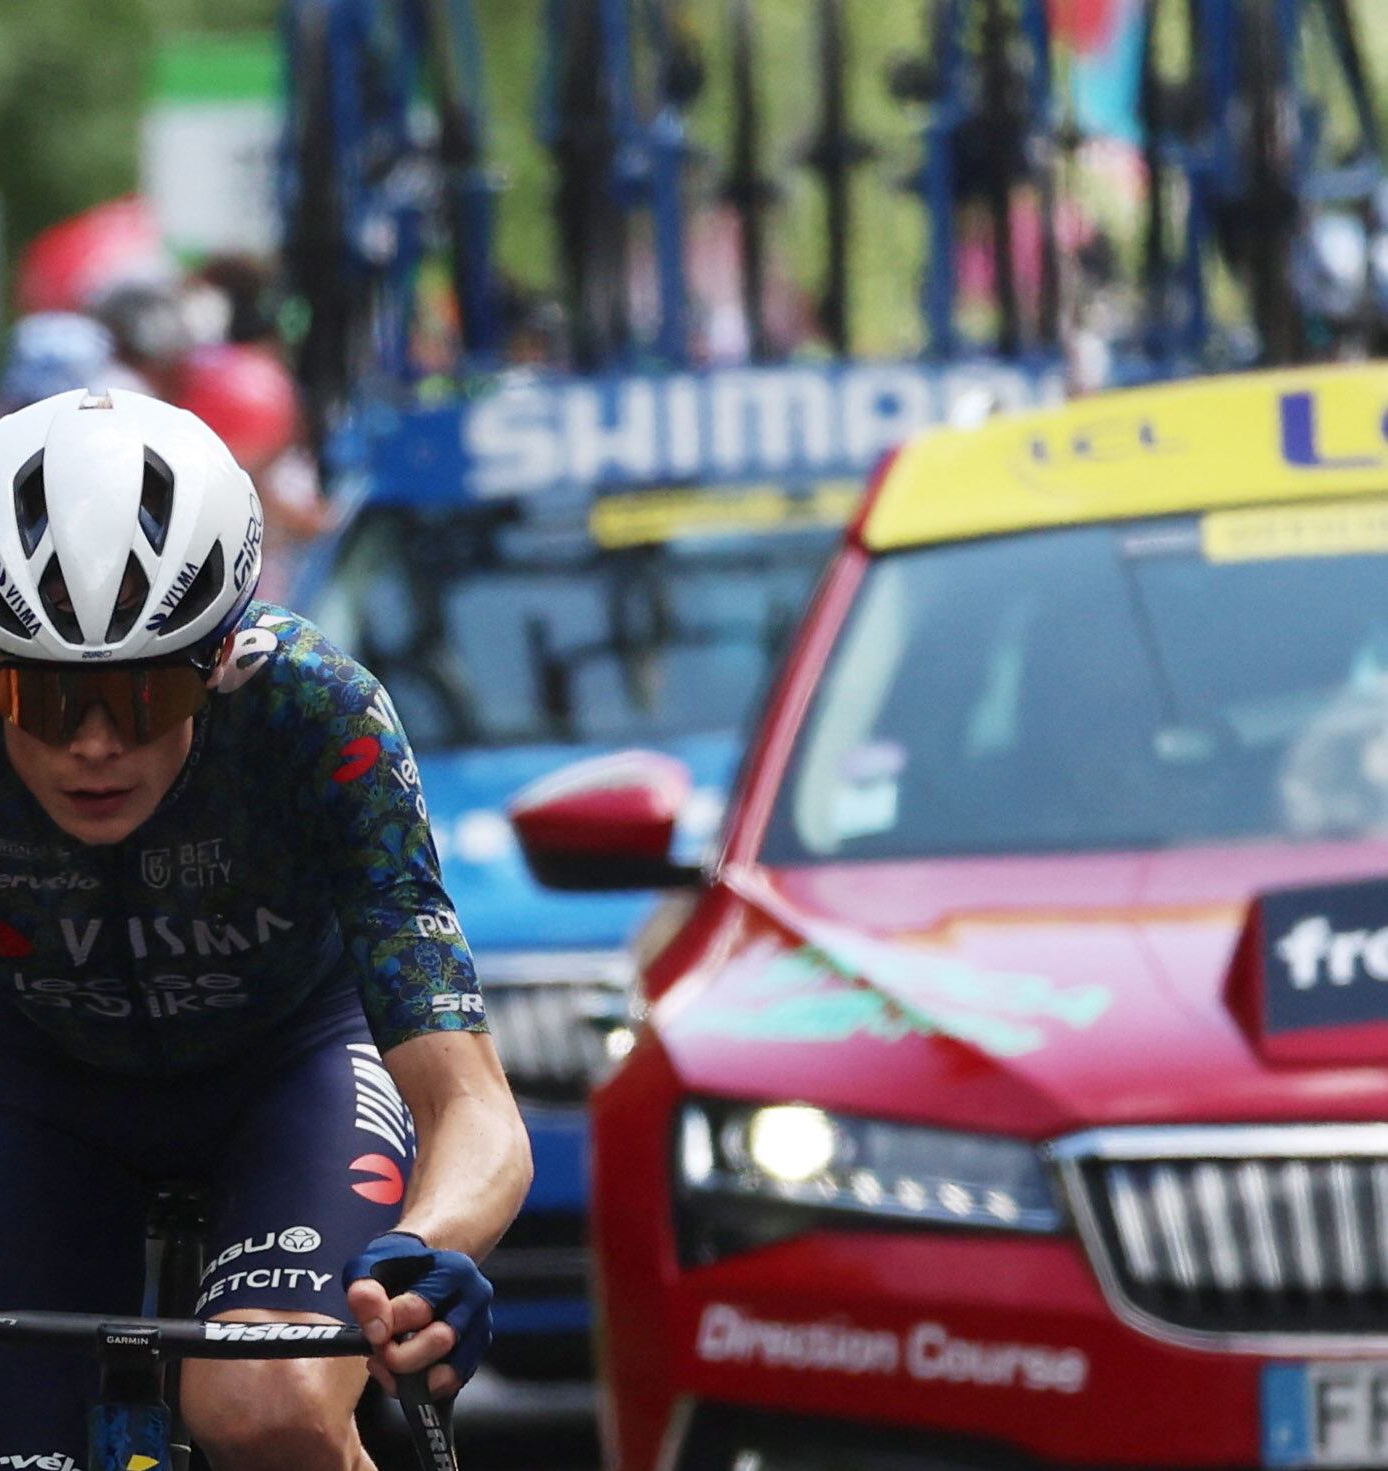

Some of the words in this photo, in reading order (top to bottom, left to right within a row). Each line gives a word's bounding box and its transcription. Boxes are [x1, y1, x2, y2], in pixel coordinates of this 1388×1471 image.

[161, 562, 199, 610] VISMA
[5, 584, 43, 637] VISMA
[181, 838, 224, 866] BET
[182, 860, 233, 887] CITY
[59, 906, 294, 967] VISMA
[194, 1268, 333, 1316] BETCITY
[107, 1335, 149, 1346] GARMIN
[203, 1321, 342, 1341] Vision
[906, 1321, 1088, 1394] Course
